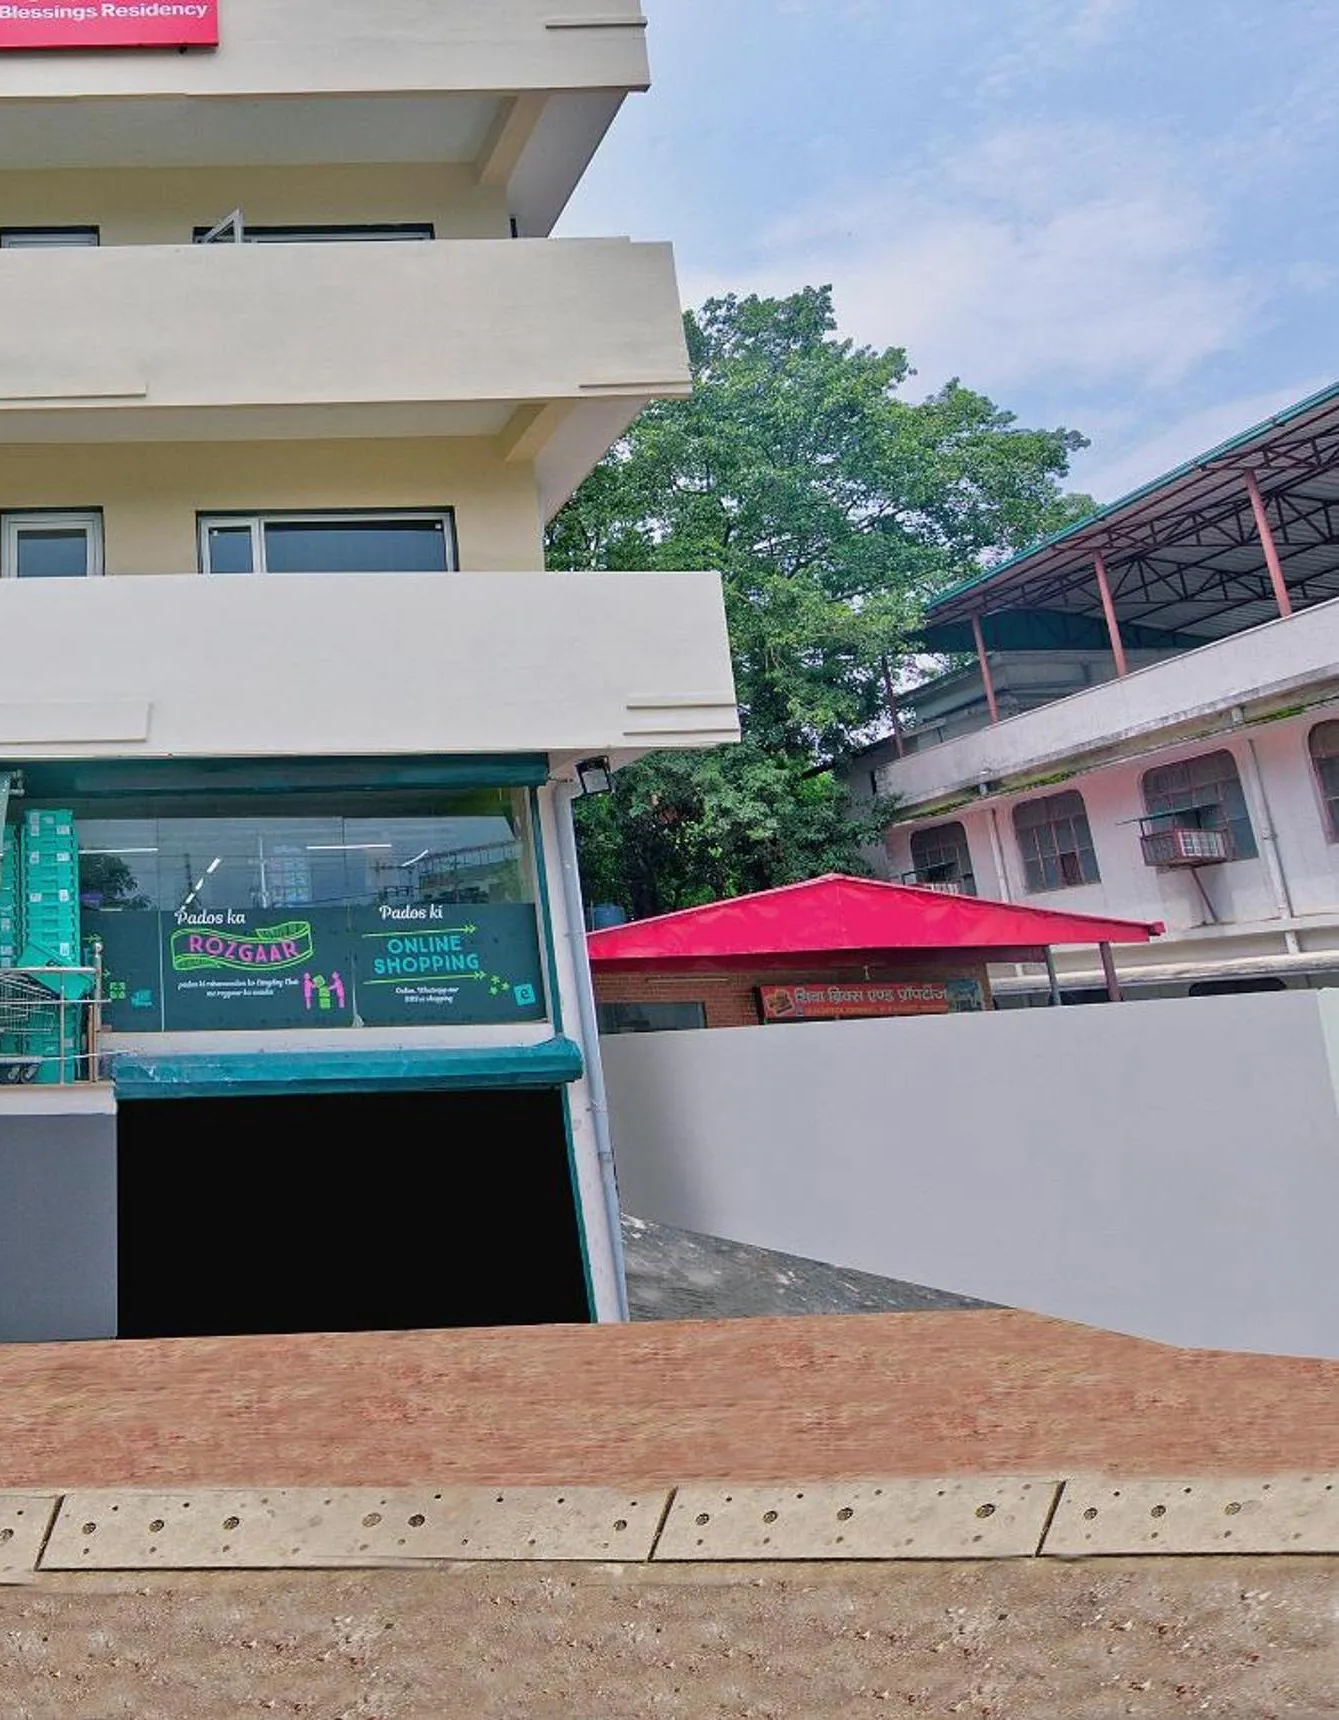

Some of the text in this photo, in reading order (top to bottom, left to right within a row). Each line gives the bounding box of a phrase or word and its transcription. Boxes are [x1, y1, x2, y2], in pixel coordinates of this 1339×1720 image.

[101, 3, 208, 18] Residency
[174, 908, 246, 925] Pados ka
[379, 903, 443, 920] Pados ki
[189, 934, 299, 962] ROZGAAR
[387, 935, 462, 954] ONLINE
[373, 953, 480, 975] SHOPPING
